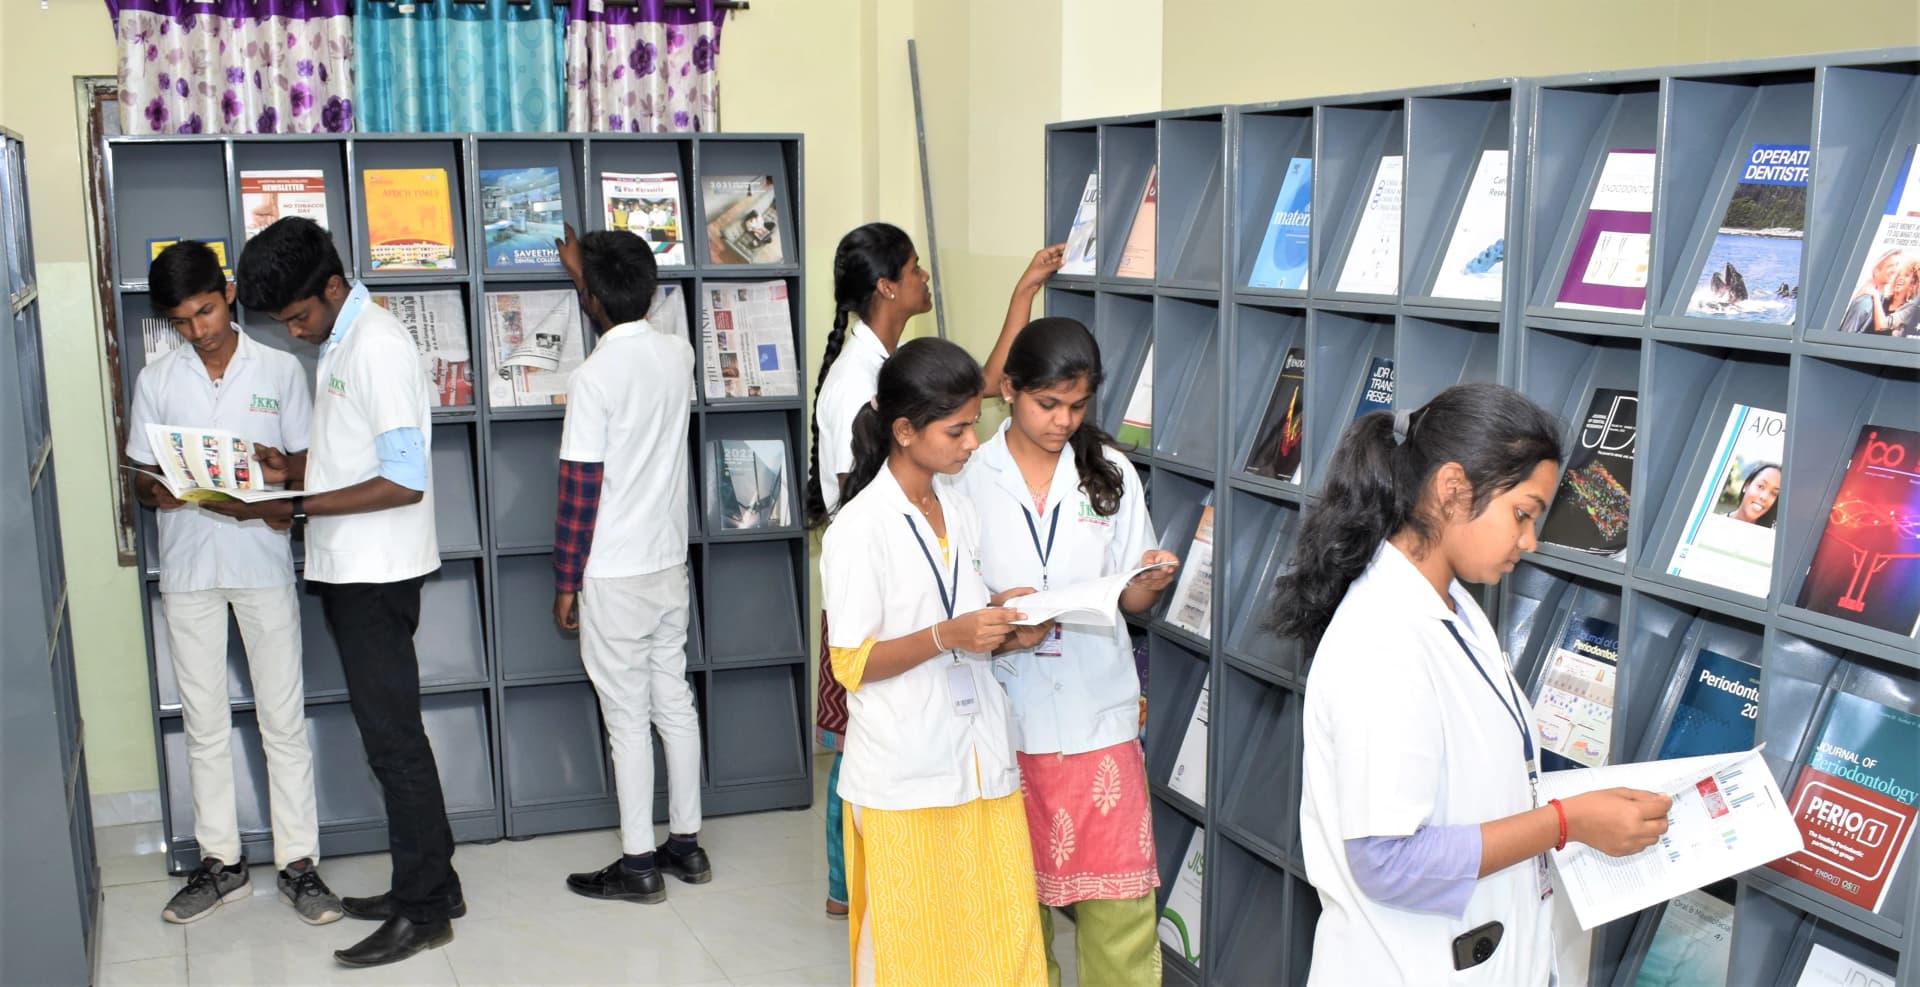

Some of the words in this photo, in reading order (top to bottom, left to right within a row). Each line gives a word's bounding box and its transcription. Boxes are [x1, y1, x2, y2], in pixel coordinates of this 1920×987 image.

[513, 249, 560, 257] SAVEETHA
[1817, 742, 1860, 765] JOURNAL
[1862, 757, 1879, 769] OF
[1812, 751, 1919, 806] Periodontology
[1804, 814, 1856, 840] PARTNERS
[1806, 795, 1864, 833] PERIO
